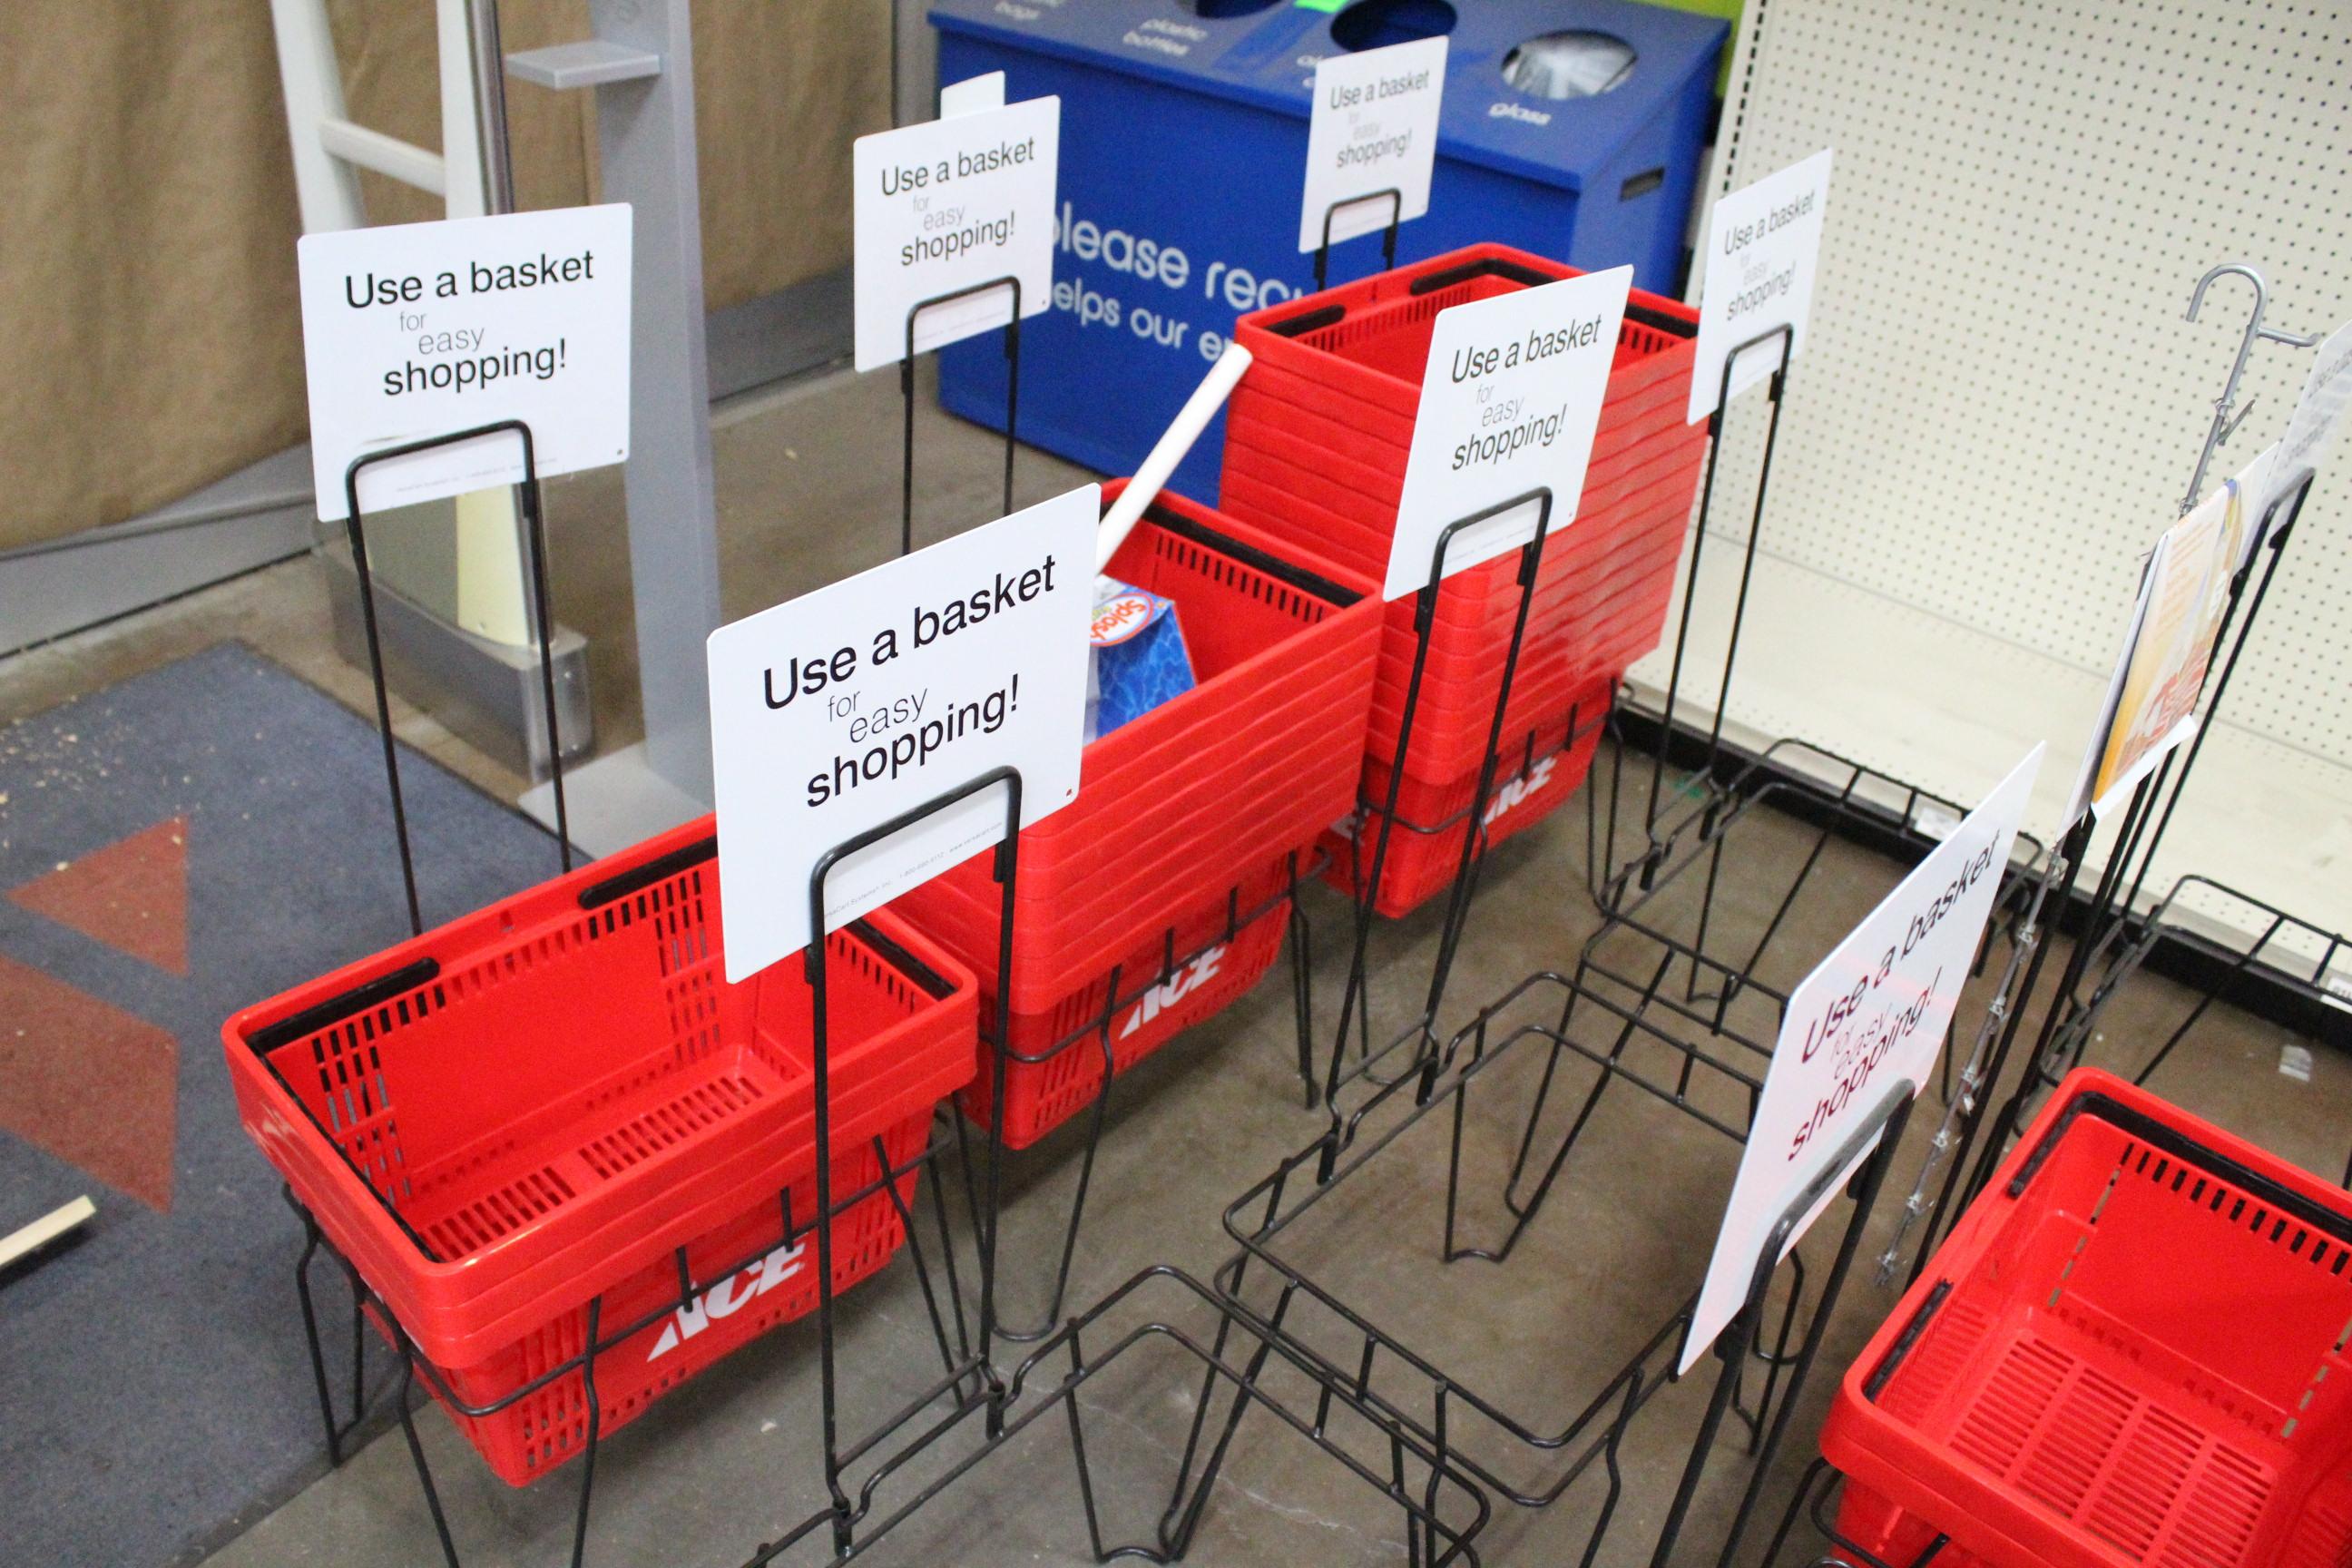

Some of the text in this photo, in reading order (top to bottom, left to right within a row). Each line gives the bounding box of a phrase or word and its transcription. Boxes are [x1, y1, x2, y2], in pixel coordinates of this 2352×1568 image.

[1330, 70, 1429, 109] Use a basket
[1488, 103, 1553, 125] glass
[882, 136, 1034, 196] Use a basket
[1337, 131, 1412, 168] shopping!
[912, 195, 929, 211] for
[923, 206, 965, 230] easy
[1724, 191, 1815, 255] Use a basket
[901, 211, 1014, 266] shopping!
[1053, 201, 1303, 309] lease rec
[345, 250, 593, 309] Use a basket
[1727, 260, 1797, 321] shopping!
[399, 311, 426, 331] for
[418, 328, 485, 355] easy
[1053, 278, 1121, 327] elps
[1130, 308, 1189, 349] our
[384, 338, 566, 396] shopping!
[1452, 313, 1602, 383] Use a basket
[1475, 383, 1494, 405] for
[1482, 396, 1525, 426] easy
[1452, 403, 1567, 471] shopping!
[764, 554, 1055, 710] Use a basket
[828, 687, 861, 723] for
[850, 687, 928, 743] easy
[807, 673, 1019, 808] shopping!
[1801, 828, 2001, 1063] Use a basket
[1119, 946, 1225, 1041] ACE
[1788, 965, 1942, 1161] shopping!
[1829, 1022, 1855, 1063] for
[1835, 1003, 1893, 1080] easy
[646, 1232, 808, 1363] ACE
